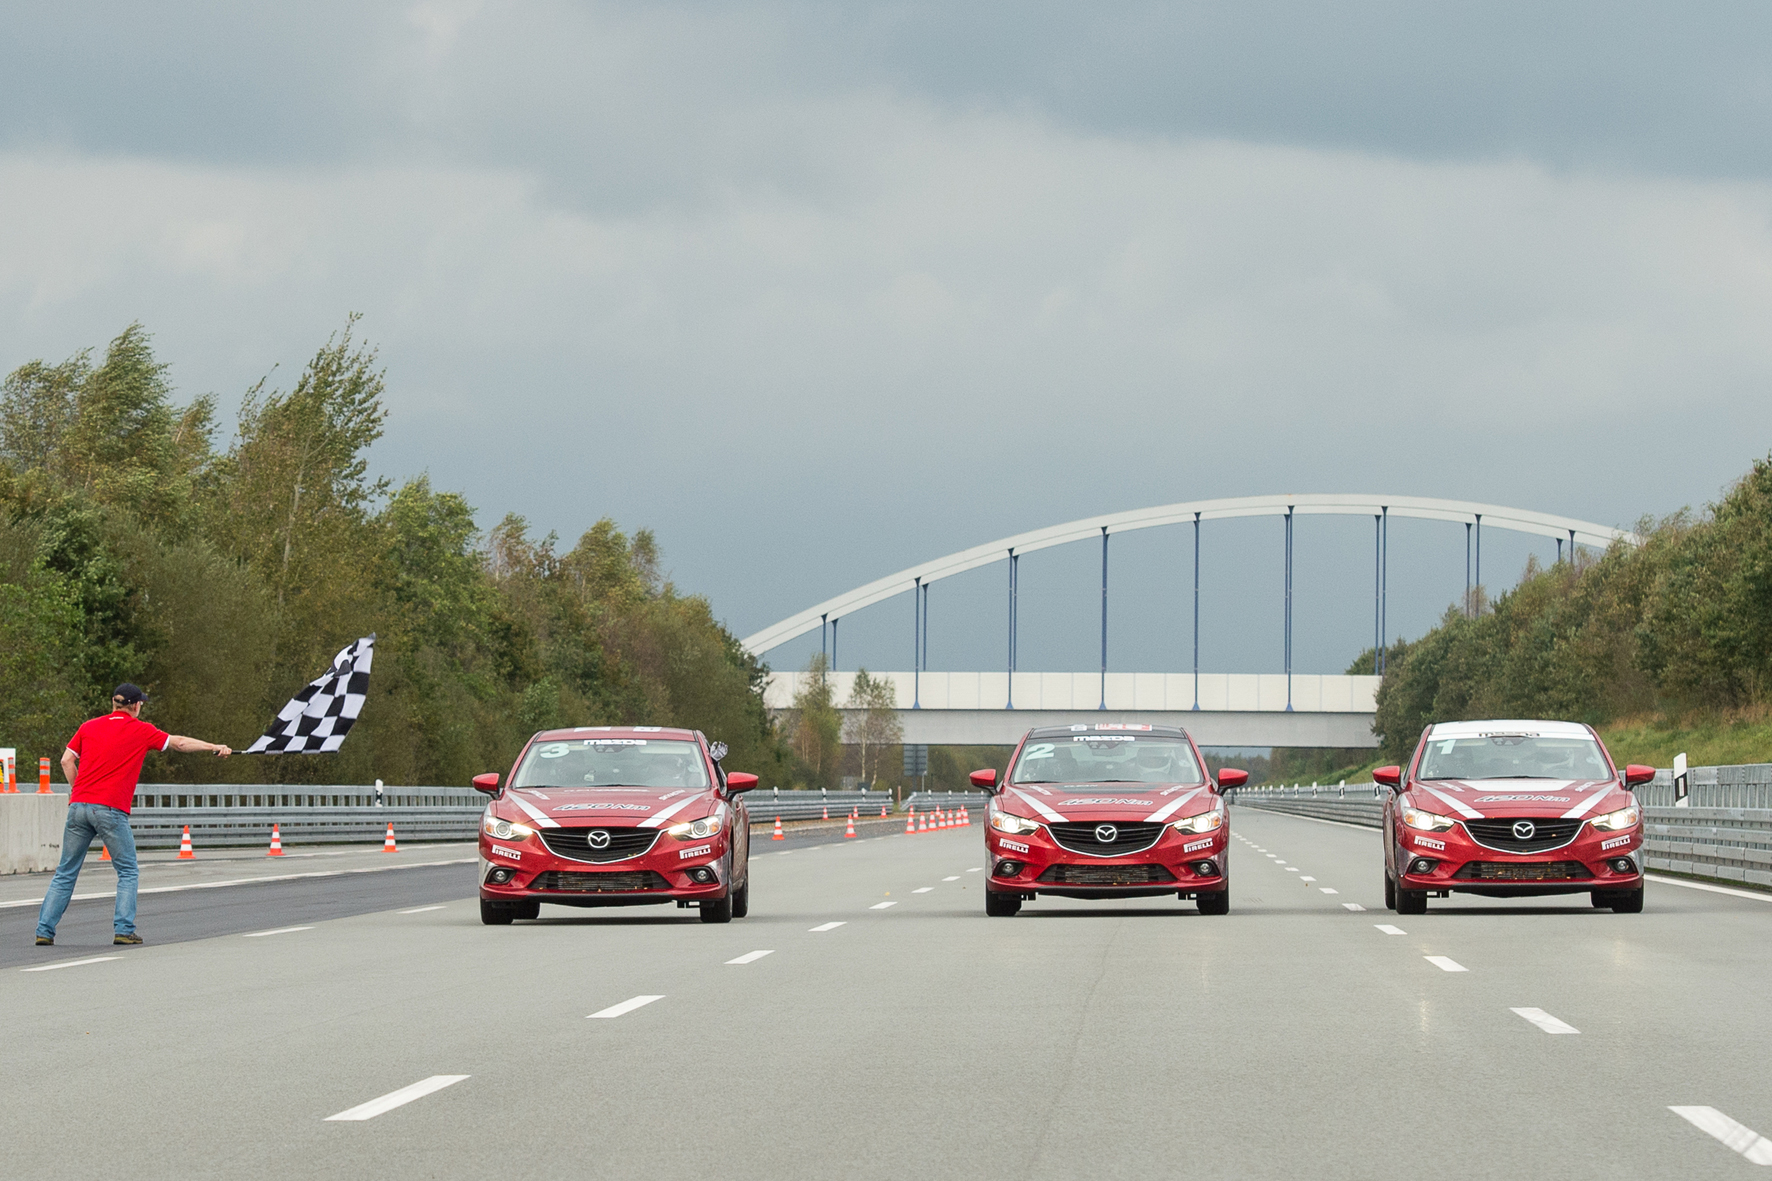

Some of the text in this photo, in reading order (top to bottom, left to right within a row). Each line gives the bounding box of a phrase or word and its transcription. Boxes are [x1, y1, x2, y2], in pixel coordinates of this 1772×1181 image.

[539, 742, 570, 758] 3
[1025, 743, 1055, 760] 2
[1436, 739, 1456, 755] 1
[999, 837, 1030, 854] PIRELLI
[1183, 837, 1214, 854] PIRELLI
[1414, 835, 1446, 851] PIRELLI
[1601, 834, 1631, 851] PIRELLI
[491, 844, 522, 861] PIRELLI
[679, 844, 711, 860] PIRELLI
